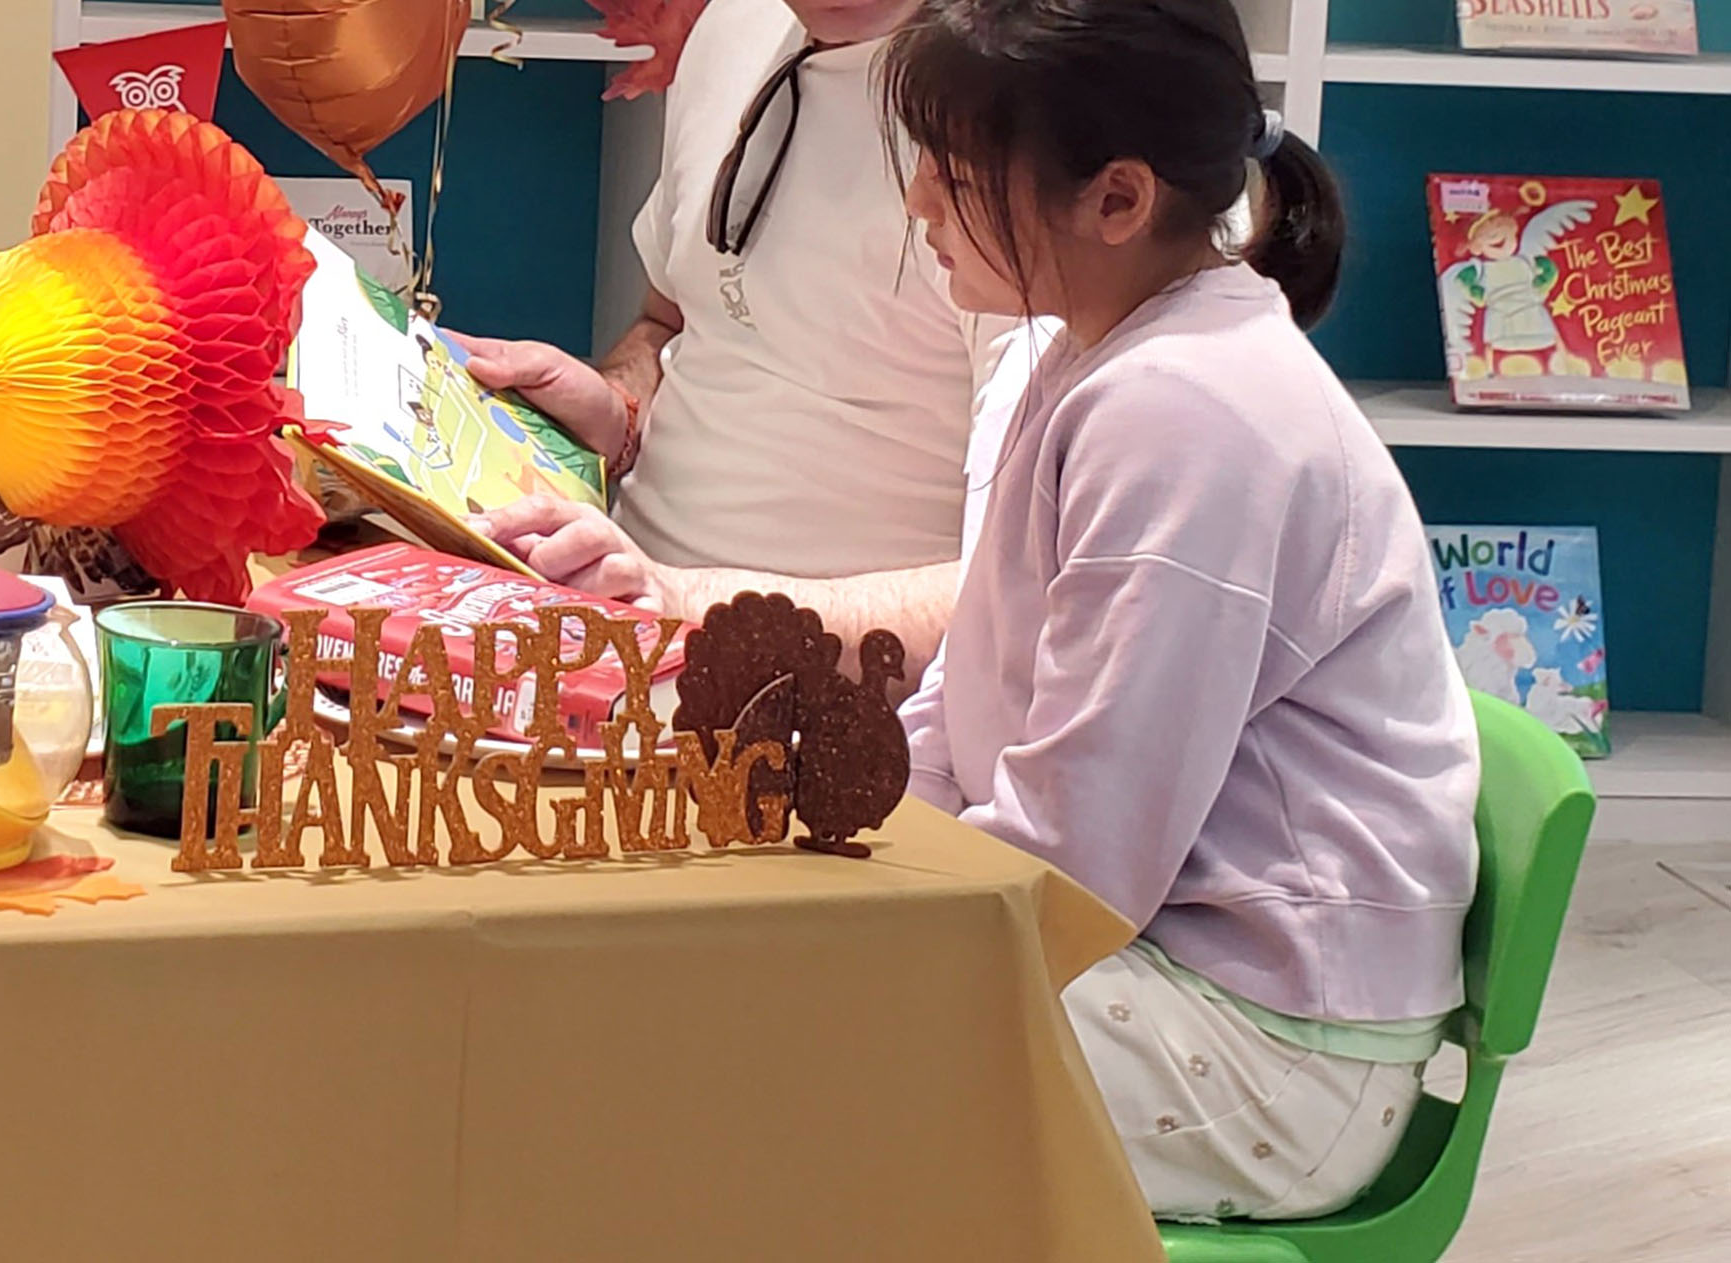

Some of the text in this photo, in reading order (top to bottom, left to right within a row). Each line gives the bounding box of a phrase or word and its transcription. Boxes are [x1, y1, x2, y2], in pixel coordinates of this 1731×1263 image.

[308, 217, 392, 240] Together
[1550, 230, 1659, 270] The Best
[1562, 271, 1673, 305] Christmas
[1578, 302, 1671, 344] Pageant
[1597, 336, 1654, 367] Ever
[1432, 530, 1556, 577] World
[1464, 570, 1560, 612] Love
[280, 603, 684, 742] HAPPY
[152, 702, 788, 872] THANKSGIVING
